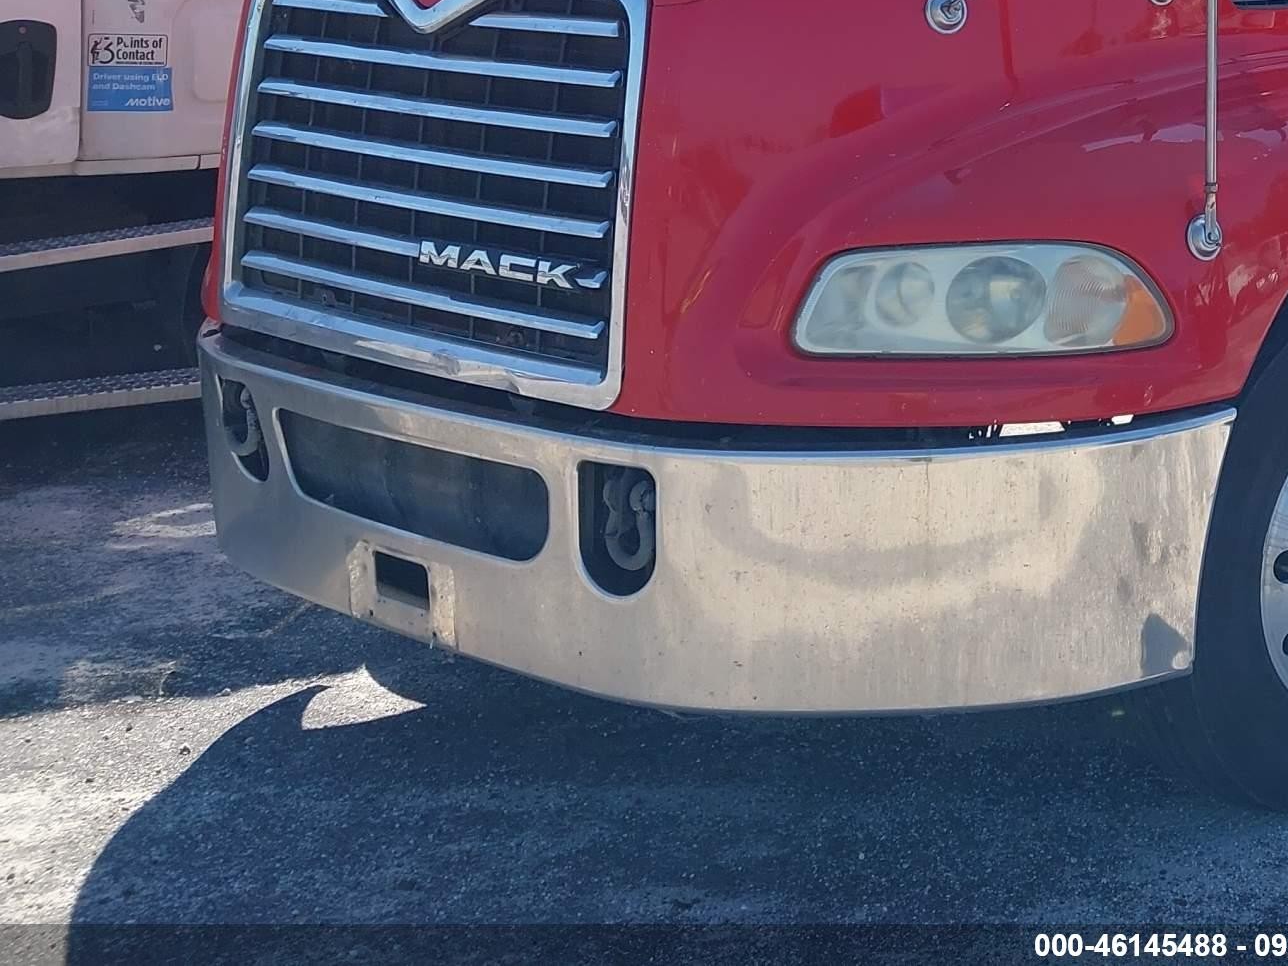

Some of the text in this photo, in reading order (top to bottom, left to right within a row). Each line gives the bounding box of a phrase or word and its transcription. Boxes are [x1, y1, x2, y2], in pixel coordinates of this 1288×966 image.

[152, 37, 163, 48] of
[116, 49, 154, 60] Contact
[93, 73, 121, 81] Driver
[124, 74, 149, 82] using
[419, 240, 579, 289] MACK
